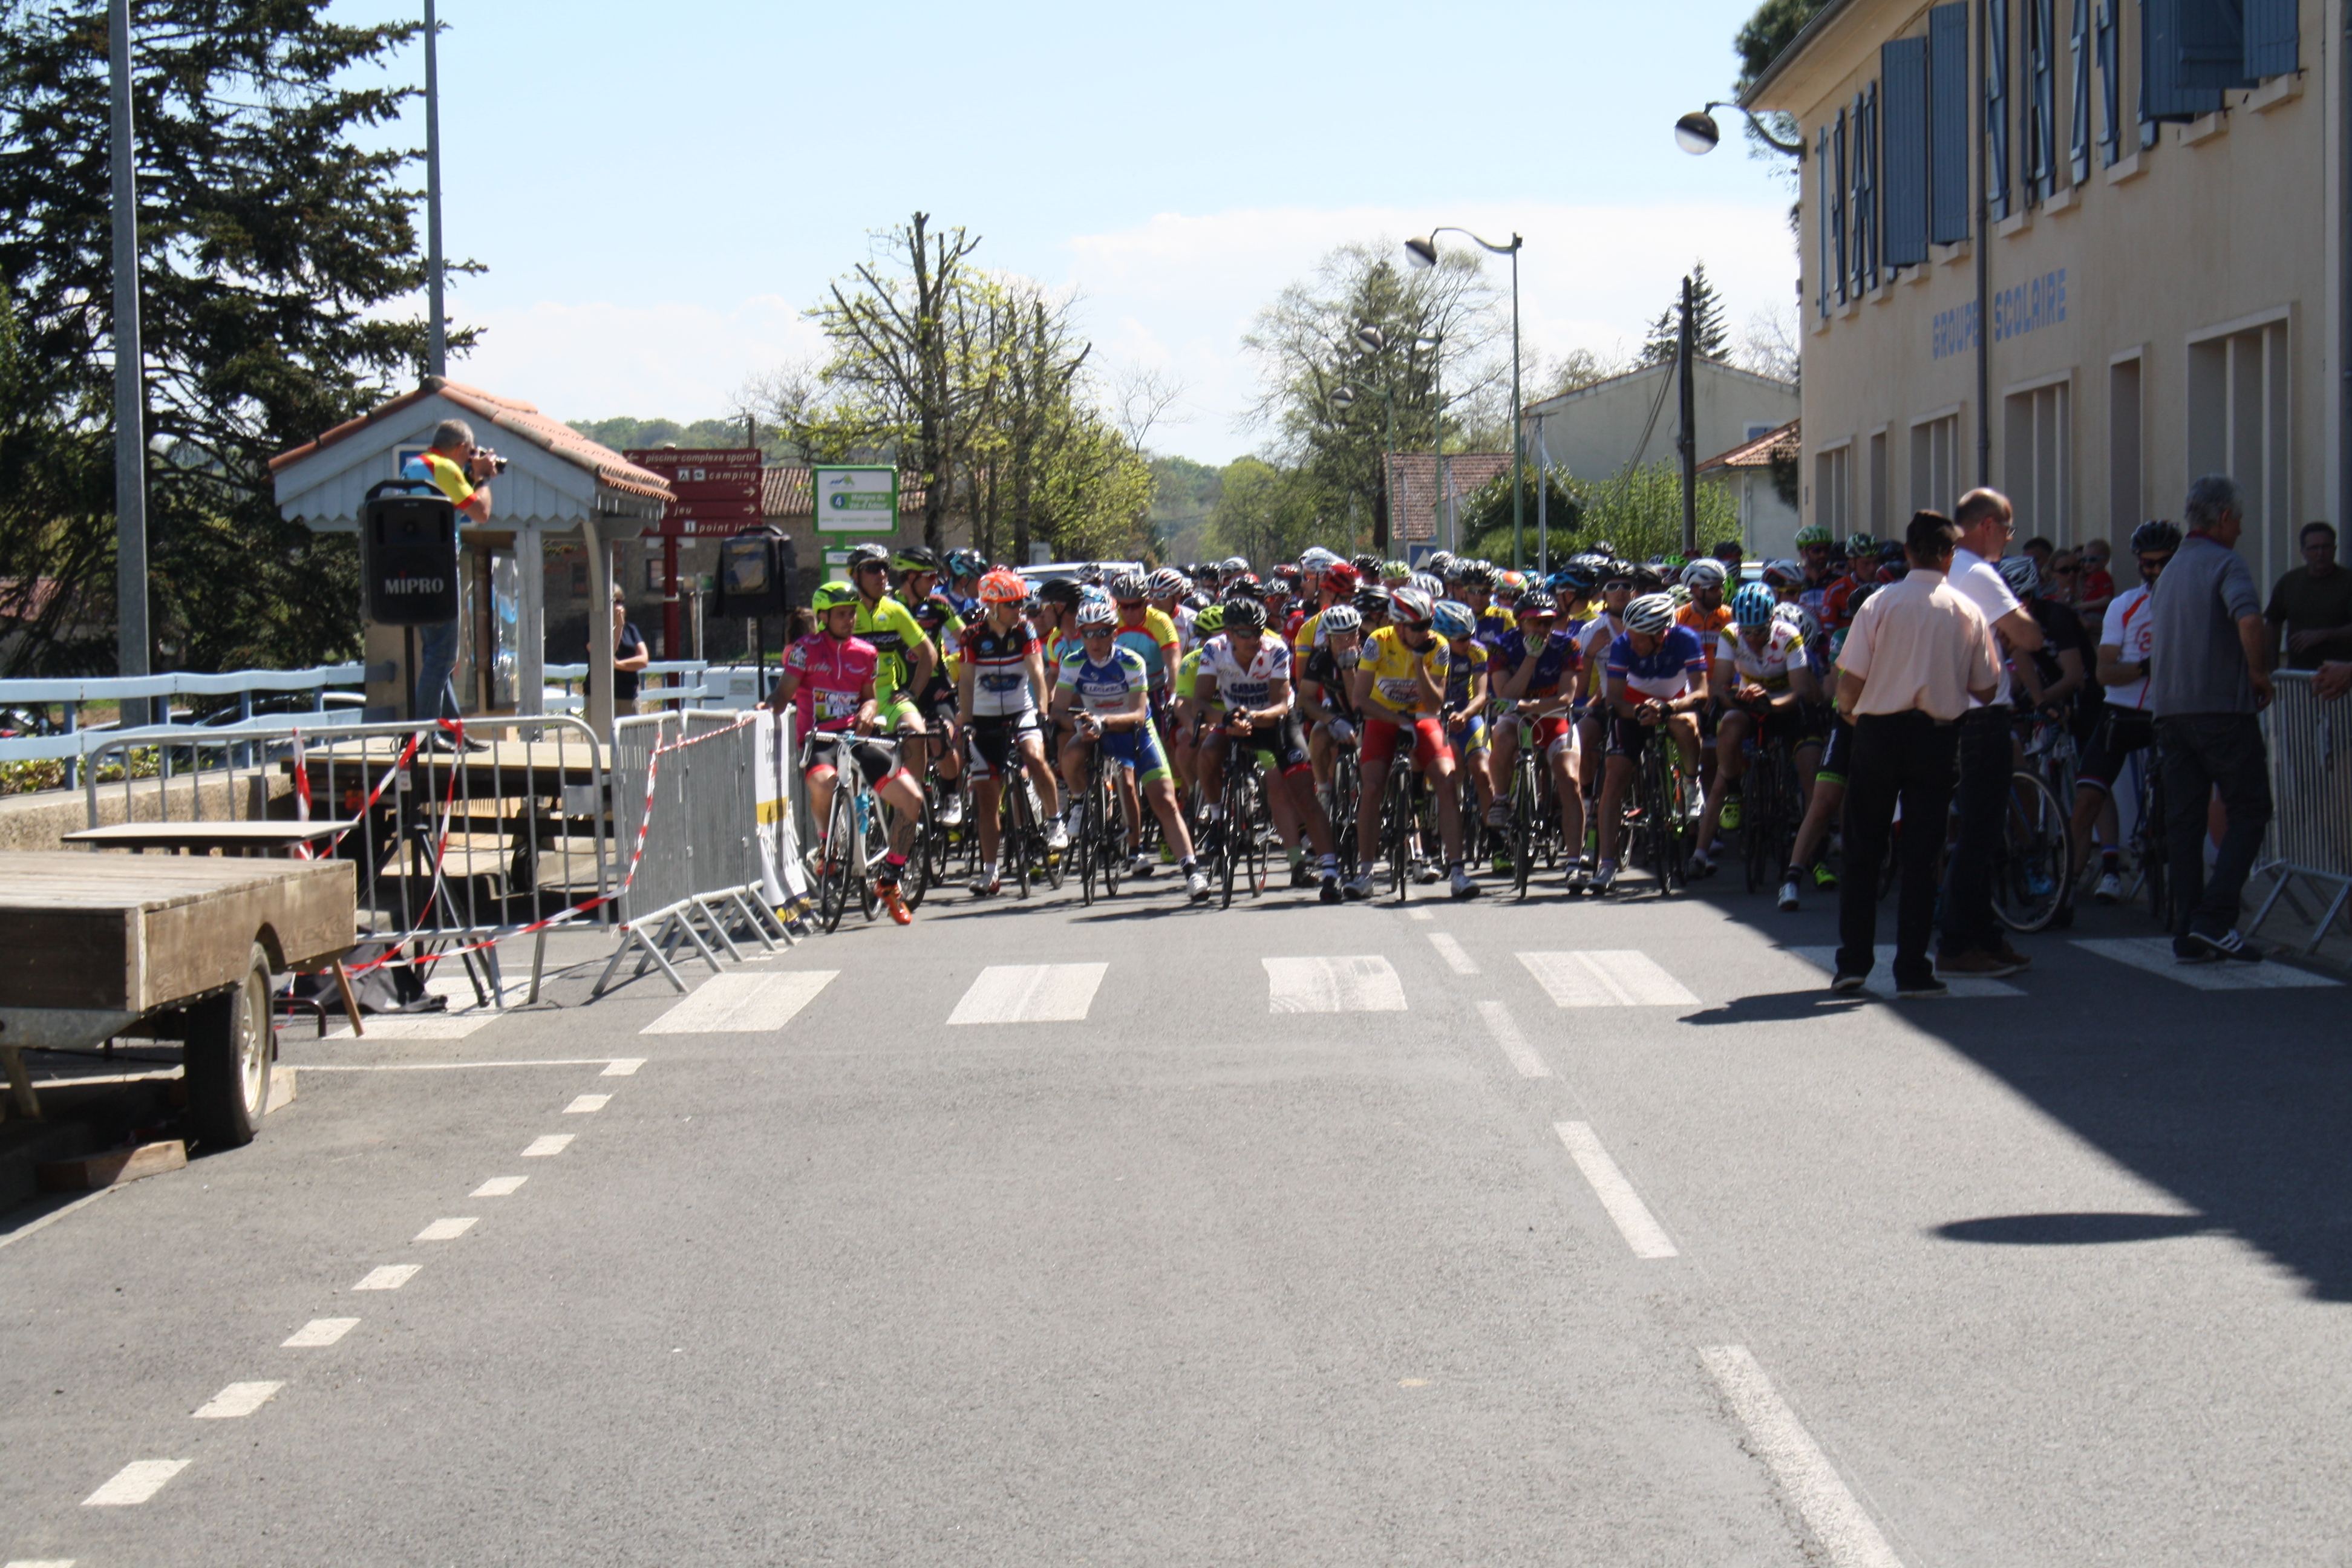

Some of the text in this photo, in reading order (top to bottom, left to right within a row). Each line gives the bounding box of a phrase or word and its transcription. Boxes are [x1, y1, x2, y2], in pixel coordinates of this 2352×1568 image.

[1932, 268, 2066, 361] GROUPE SCOLAIRE
[726, 451, 757, 464] sportif
[708, 471, 757, 482] camping
[835, 496, 843, 508] 4
[673, 505, 693, 517] jeu
[698, 522, 729, 534] point
[385, 572, 445, 595] MIPRO
[1230, 682, 1269, 694] GARAGE
